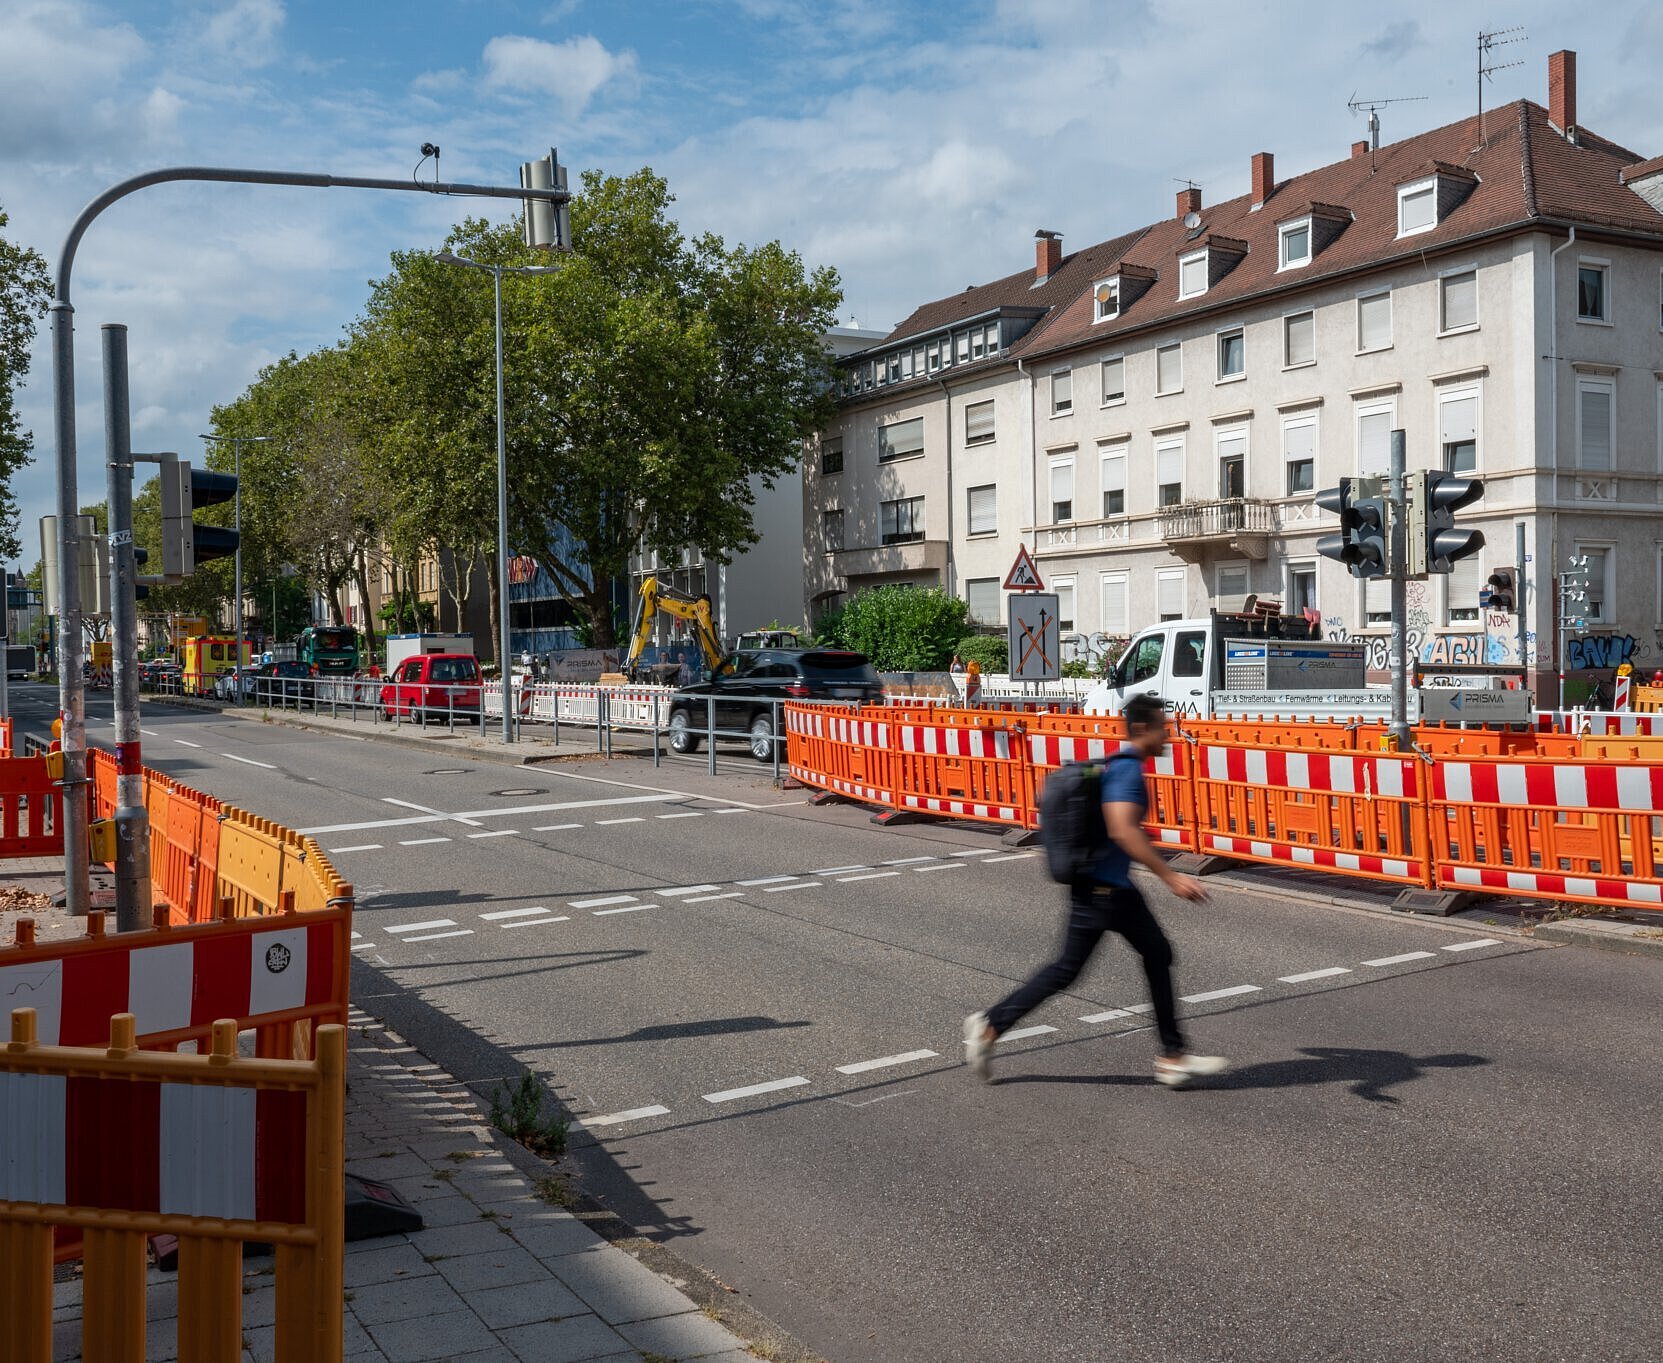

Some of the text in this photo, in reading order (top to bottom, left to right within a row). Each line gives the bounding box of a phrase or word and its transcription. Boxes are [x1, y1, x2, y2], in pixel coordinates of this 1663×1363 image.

[566, 659, 602, 668] PRISMA
[1218, 694, 1232, 703] Tief-
[1233, 694, 1238, 703] &
[1239, 694, 1276, 703] Straßenbau
[1285, 694, 1323, 703] Fernwärme
[1334, 694, 1367, 704] Leitungs-
[1368, 694, 1375, 703] &
[1465, 693, 1504, 703] PRISMA
